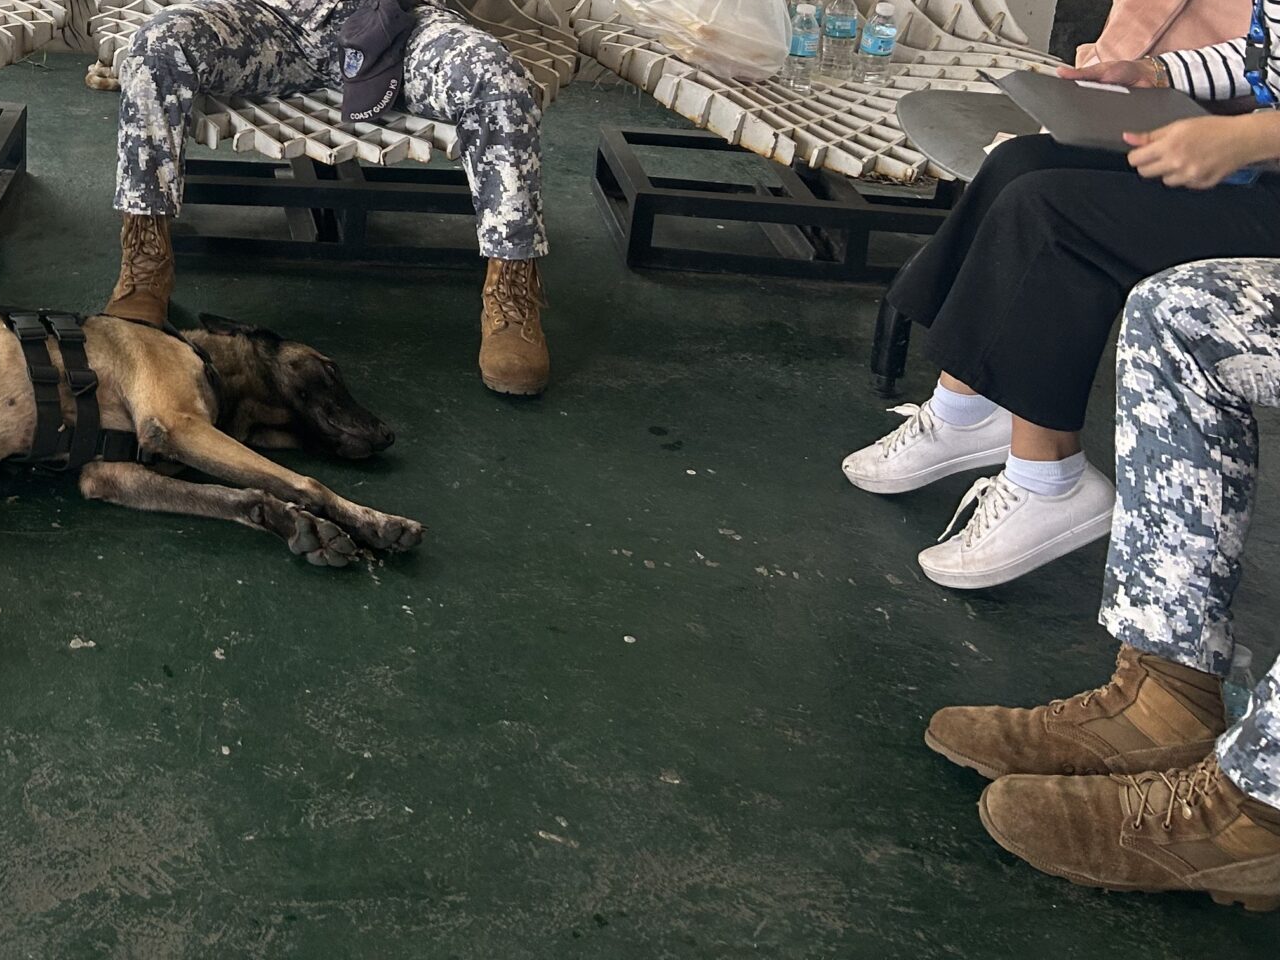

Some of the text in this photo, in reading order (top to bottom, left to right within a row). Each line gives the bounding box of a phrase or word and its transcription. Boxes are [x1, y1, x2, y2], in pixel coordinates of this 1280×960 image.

[350, 78, 398, 120] COAST GUARD K9
